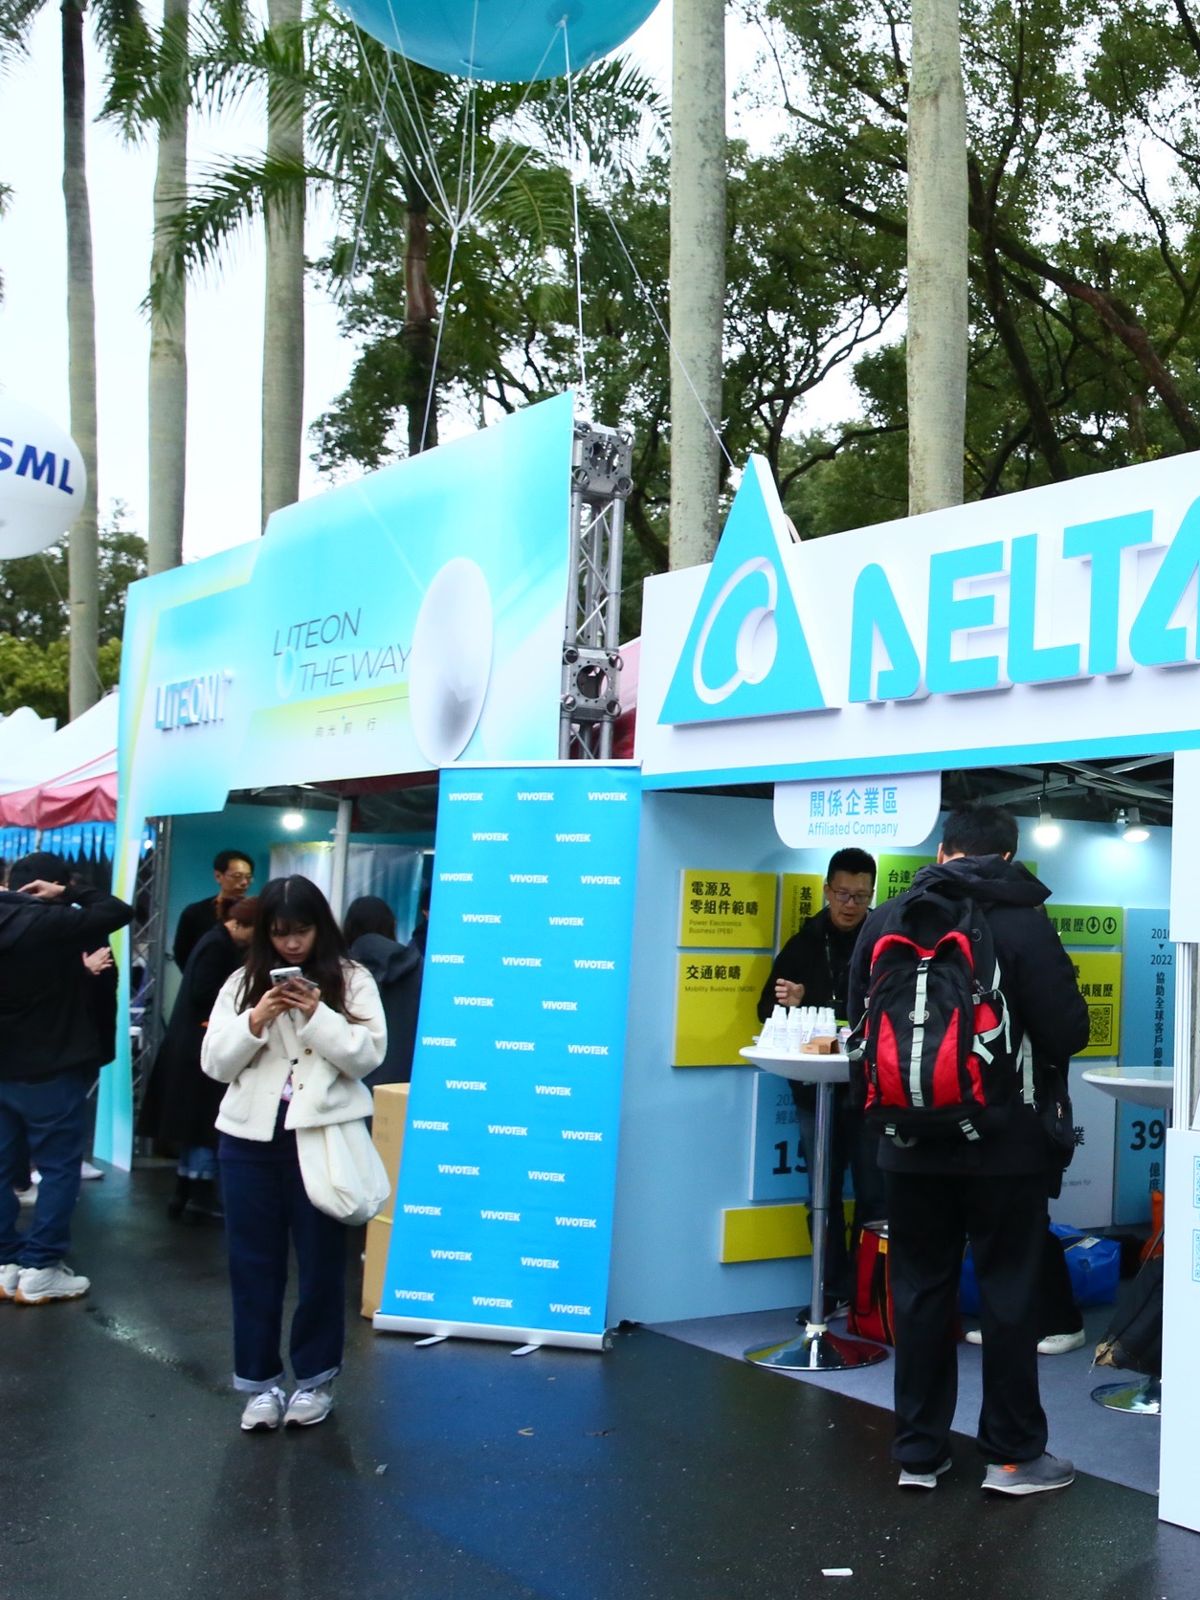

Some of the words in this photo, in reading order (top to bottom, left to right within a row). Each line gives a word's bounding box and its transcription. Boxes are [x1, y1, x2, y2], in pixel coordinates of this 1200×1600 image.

[272, 608, 361, 656] LITEON
[300, 655, 347, 692] THE
[352, 644, 412, 681] WAY
[448, 792, 484, 801] VIVOTEK
[517, 792, 554, 801] VIVOTEK
[587, 792, 627, 801] VIVOTEK
[809, 786, 898, 817] 關係企業區
[472, 832, 509, 841] VIVOTEK
[555, 833, 591, 842] VIVOTEK
[808, 822, 850, 836] Affiliated
[853, 821, 898, 837] Company
[440, 872, 473, 882] VIVOTEK
[510, 874, 548, 884] VIVOTEK
[581, 875, 621, 885] VIVOTEK
[888, 869, 917, 884] 台達
[691, 881, 731, 897] 電源及
[800, 886, 813, 920] 基礎
[462, 914, 501, 923] VIVOTEK
[549, 917, 584, 926] VIVOTEK
[1151, 928, 1170, 940] 201
[431, 954, 464, 964] VIVOTEK
[502, 957, 542, 967] VIVOTEK
[574, 960, 614, 969] VIVOTEK
[1151, 954, 1173, 966] 2022
[686, 965, 741, 980] 交通範疇
[454, 997, 494, 1007] VIVOTEK
[542, 1001, 577, 1011] VIVOTEK
[422, 1037, 456, 1046] VIVOTEK
[495, 1041, 534, 1051] VIVOTEK
[568, 1045, 608, 1055] VIVOTEK
[446, 1080, 486, 1090] VIVOTEK
[535, 1086, 571, 1096] VIVOTEK
[413, 1120, 448, 1131] VIVOTEK
[488, 1125, 527, 1136] VIVOTEK
[562, 1131, 602, 1141] VIVOTEK
[1130, 1119, 1165, 1151] 39
[438, 1165, 479, 1175] VIVOTEK
[528, 1171, 565, 1182] VIVOTEK
[404, 1205, 441, 1215] VIVOTEK
[481, 1210, 520, 1221] VIVOTEK
[556, 1217, 596, 1228] VIVOTEK
[431, 1250, 472, 1260] VIVOTEK
[521, 1258, 558, 1268] VIVOTEK
[395, 1290, 434, 1301] VIVOTEK
[473, 1297, 512, 1308] VIVOTEK
[550, 1304, 590, 1315] VIVOTEK
